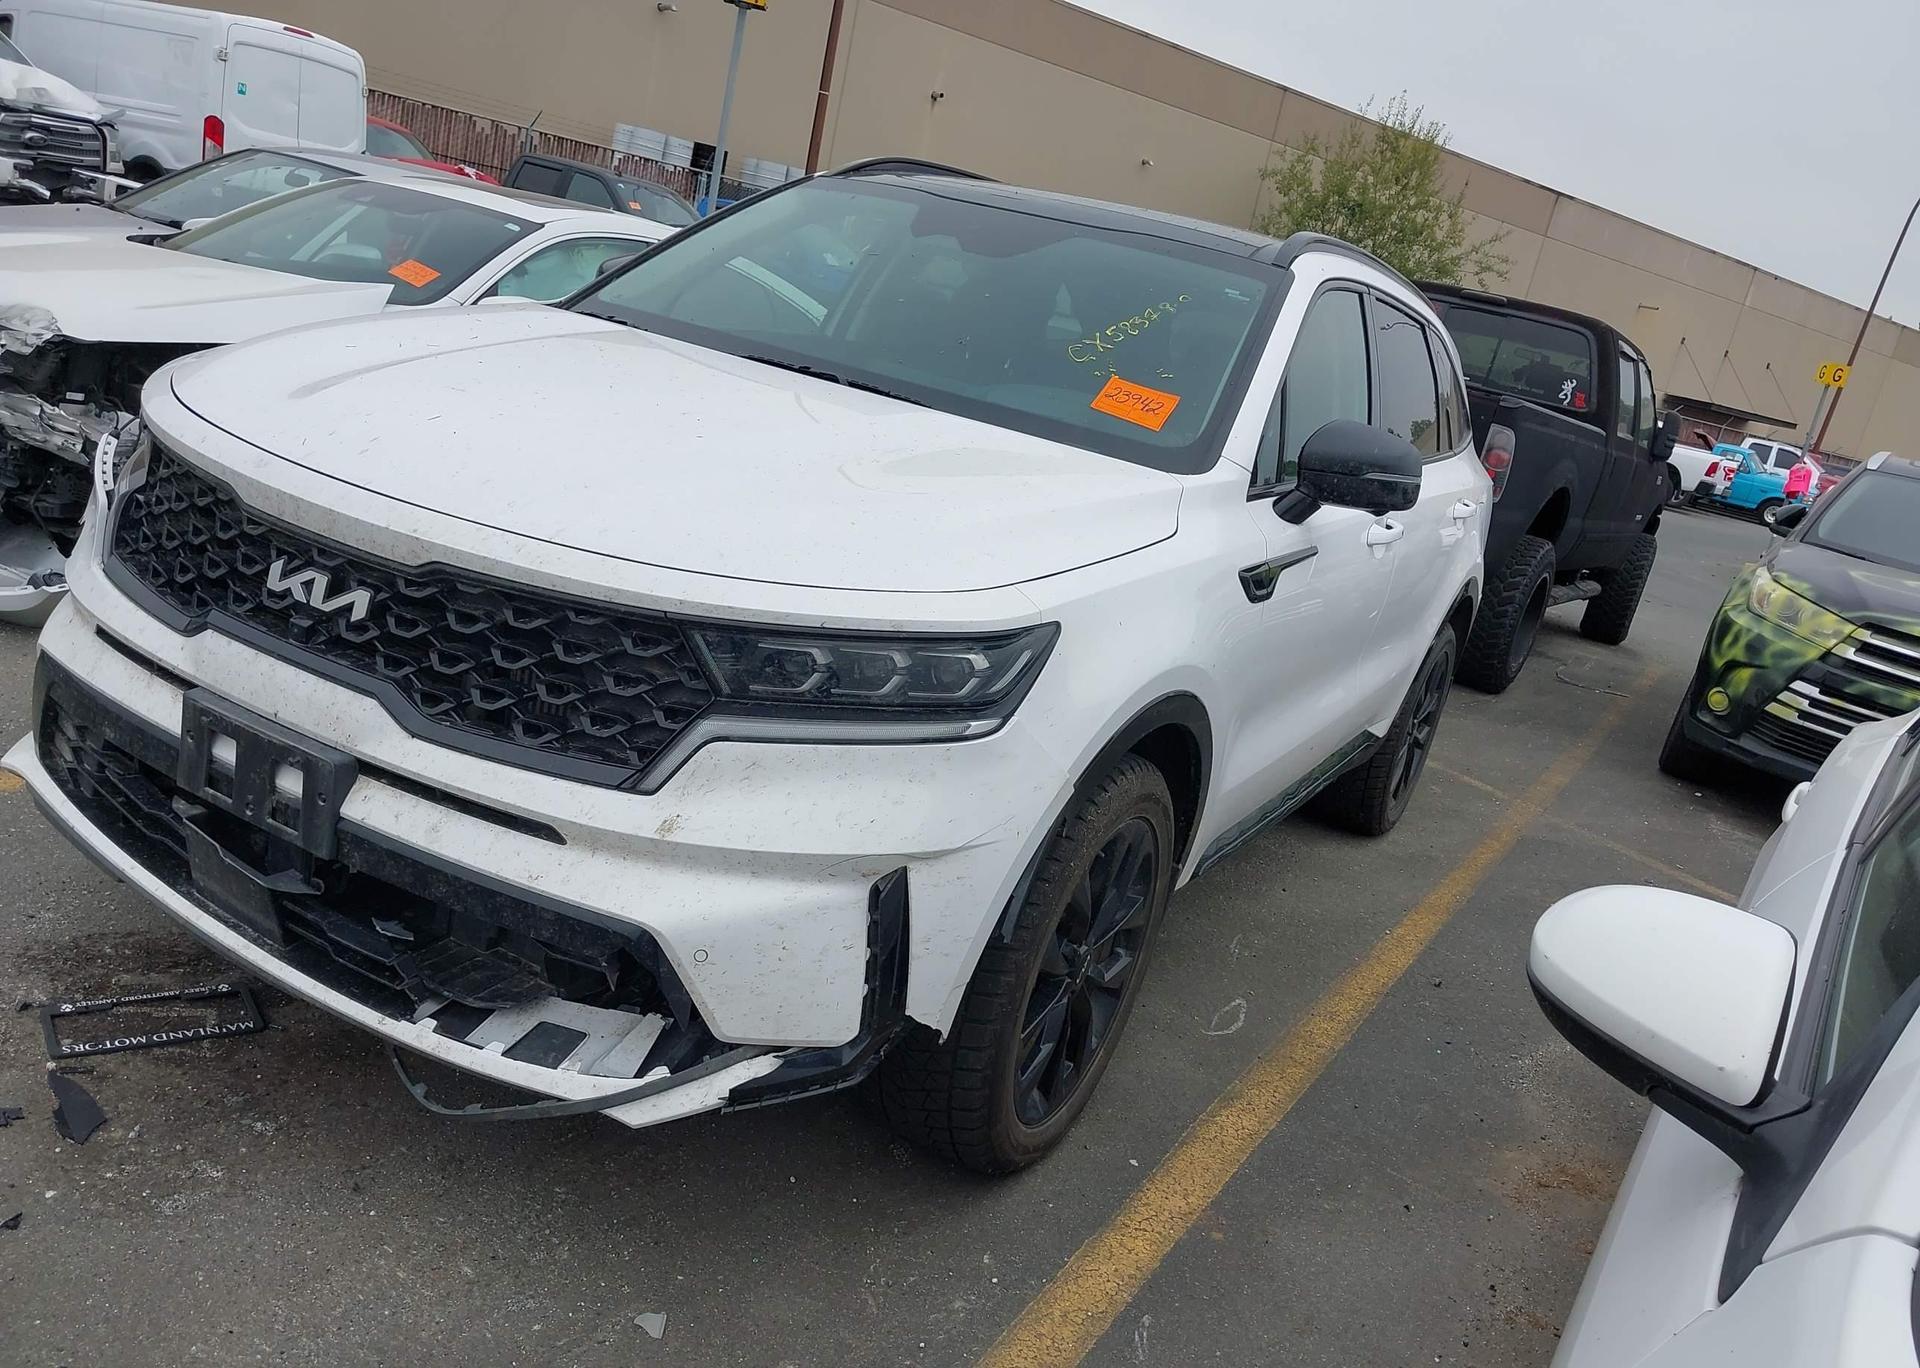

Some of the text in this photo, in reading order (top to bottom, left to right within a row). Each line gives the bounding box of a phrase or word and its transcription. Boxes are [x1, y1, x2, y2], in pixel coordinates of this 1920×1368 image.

[1818, 364, 1828, 380] G
[1832, 367, 1844, 383] G
[1104, 386, 1165, 416] 23942
